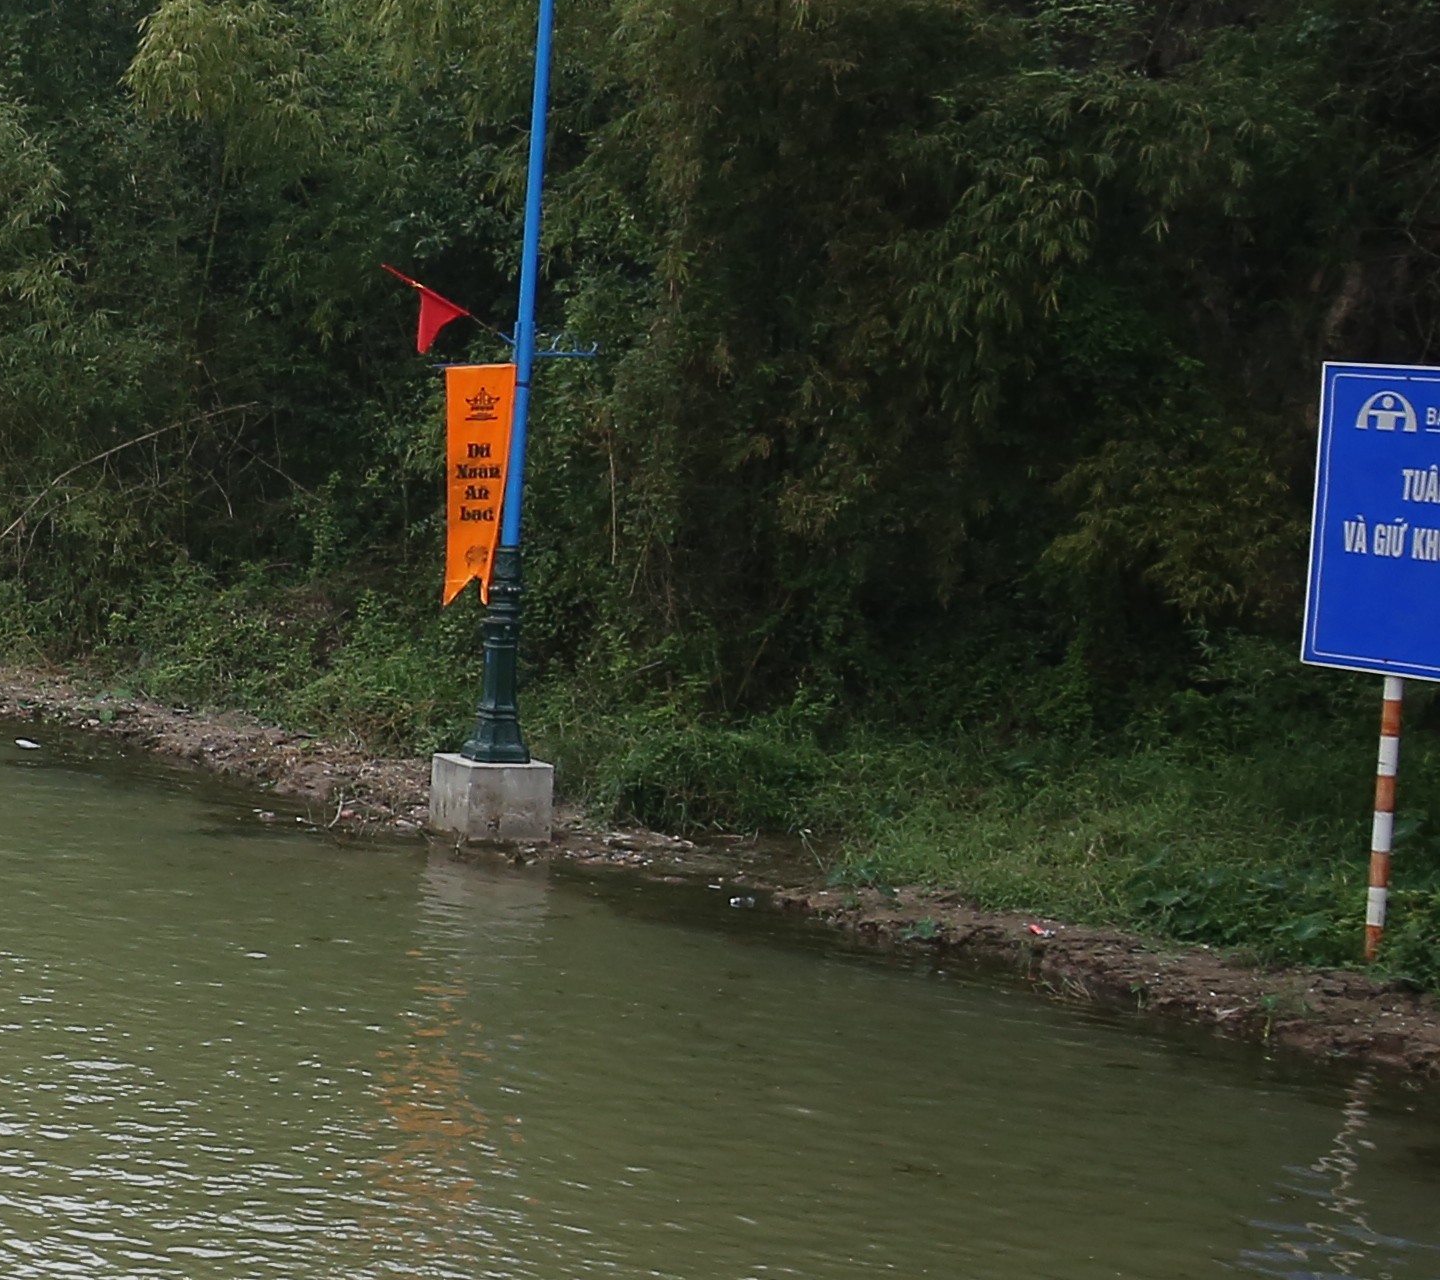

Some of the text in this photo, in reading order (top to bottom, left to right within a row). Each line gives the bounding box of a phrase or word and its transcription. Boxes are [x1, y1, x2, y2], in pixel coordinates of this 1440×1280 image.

[1343, 514, 1440, 561] VÀ GIỮ KH
